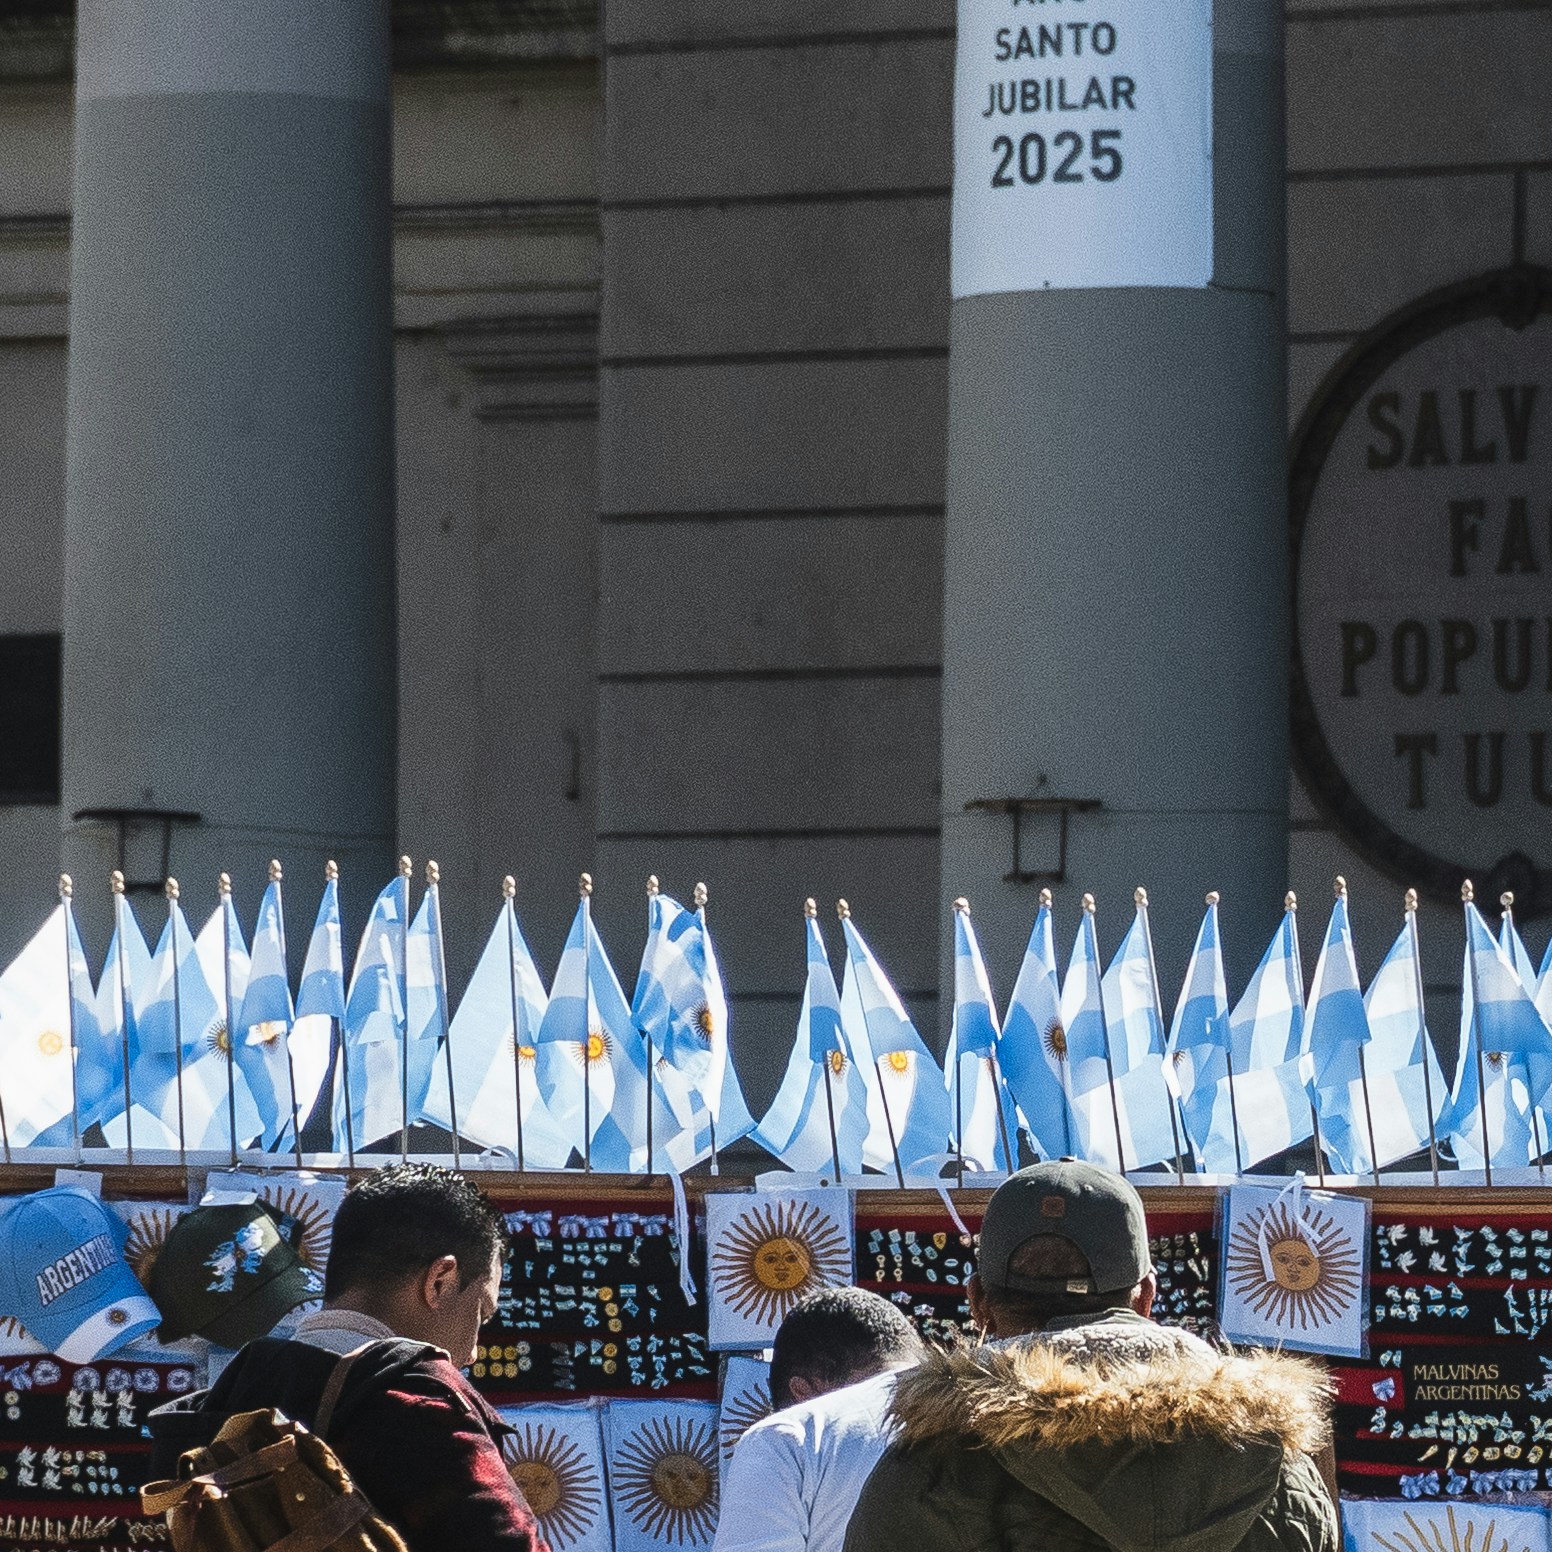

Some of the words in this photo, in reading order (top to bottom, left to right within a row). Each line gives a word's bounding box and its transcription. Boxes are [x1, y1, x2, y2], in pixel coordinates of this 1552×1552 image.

[995, 22, 1116, 61] SANTO
[983, 76, 1136, 117] JUBILAR
[992, 129, 1123, 187] 2025
[1413, 1364, 1499, 1381] MALVINAS
[1415, 1385, 1521, 1401] ARGENTINAS
